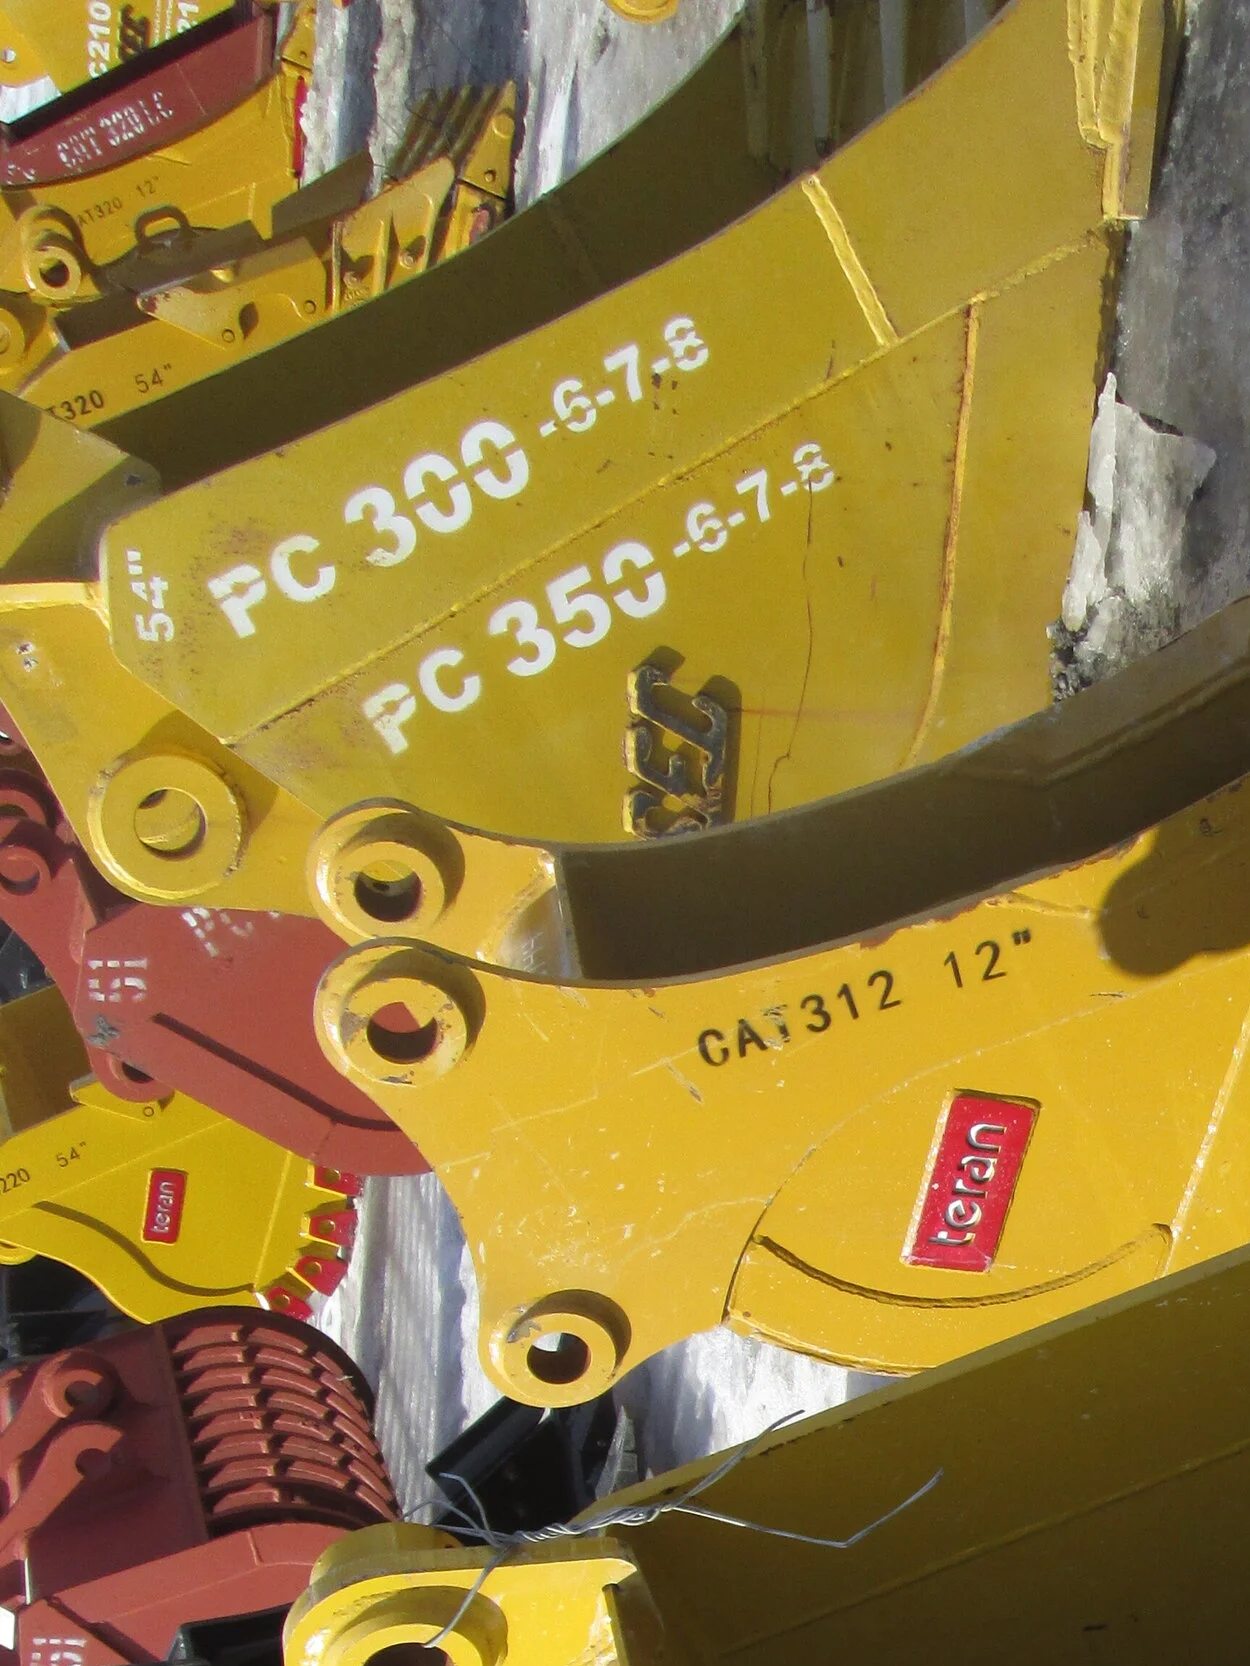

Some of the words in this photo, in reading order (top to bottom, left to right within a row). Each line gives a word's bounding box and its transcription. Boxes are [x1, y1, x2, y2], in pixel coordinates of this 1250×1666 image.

[134, 363, 174, 393] 54"
[126, 550, 176, 643] 54"
[207, 534, 337, 641] PC
[362, 647, 483, 756] PC
[696, 968, 903, 1069] CAT312
[943, 927, 1033, 989] 12"
[55, 1140, 88, 1170] 54"
[928, 1121, 1009, 1248] teran
[148, 1180, 178, 1236] teran
